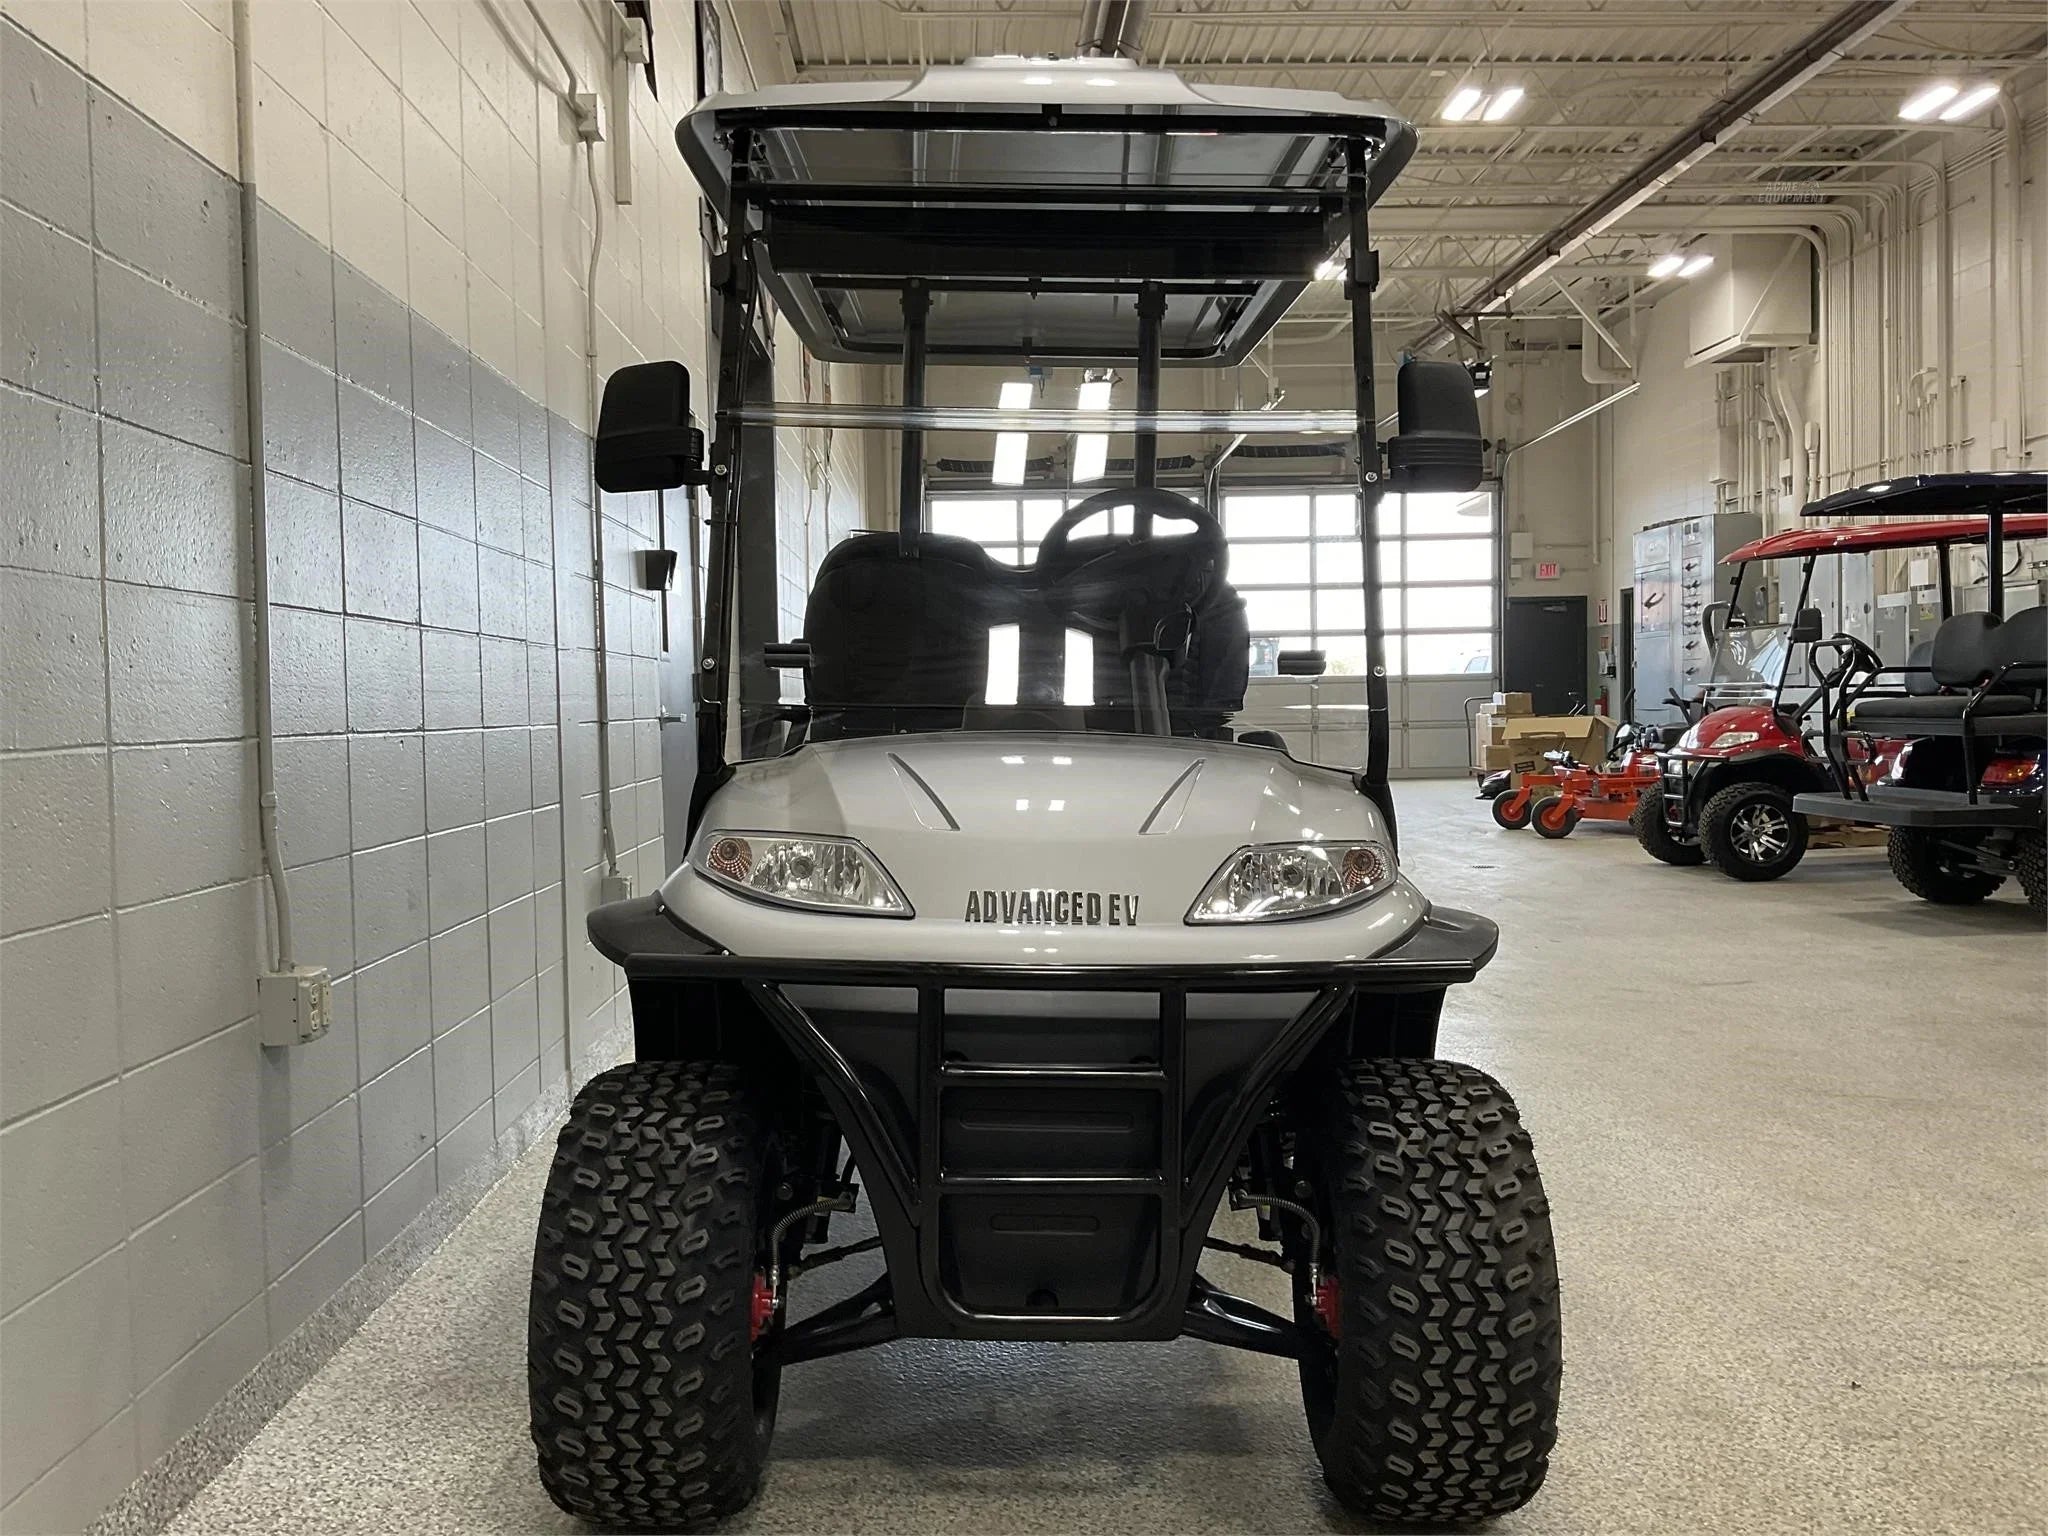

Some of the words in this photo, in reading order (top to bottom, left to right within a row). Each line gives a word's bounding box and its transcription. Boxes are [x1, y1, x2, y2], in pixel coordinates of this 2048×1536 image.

[1540, 563, 1557, 577] EXIT
[965, 889, 1102, 926] ADVANCED
[1108, 893, 1140, 926] EV
